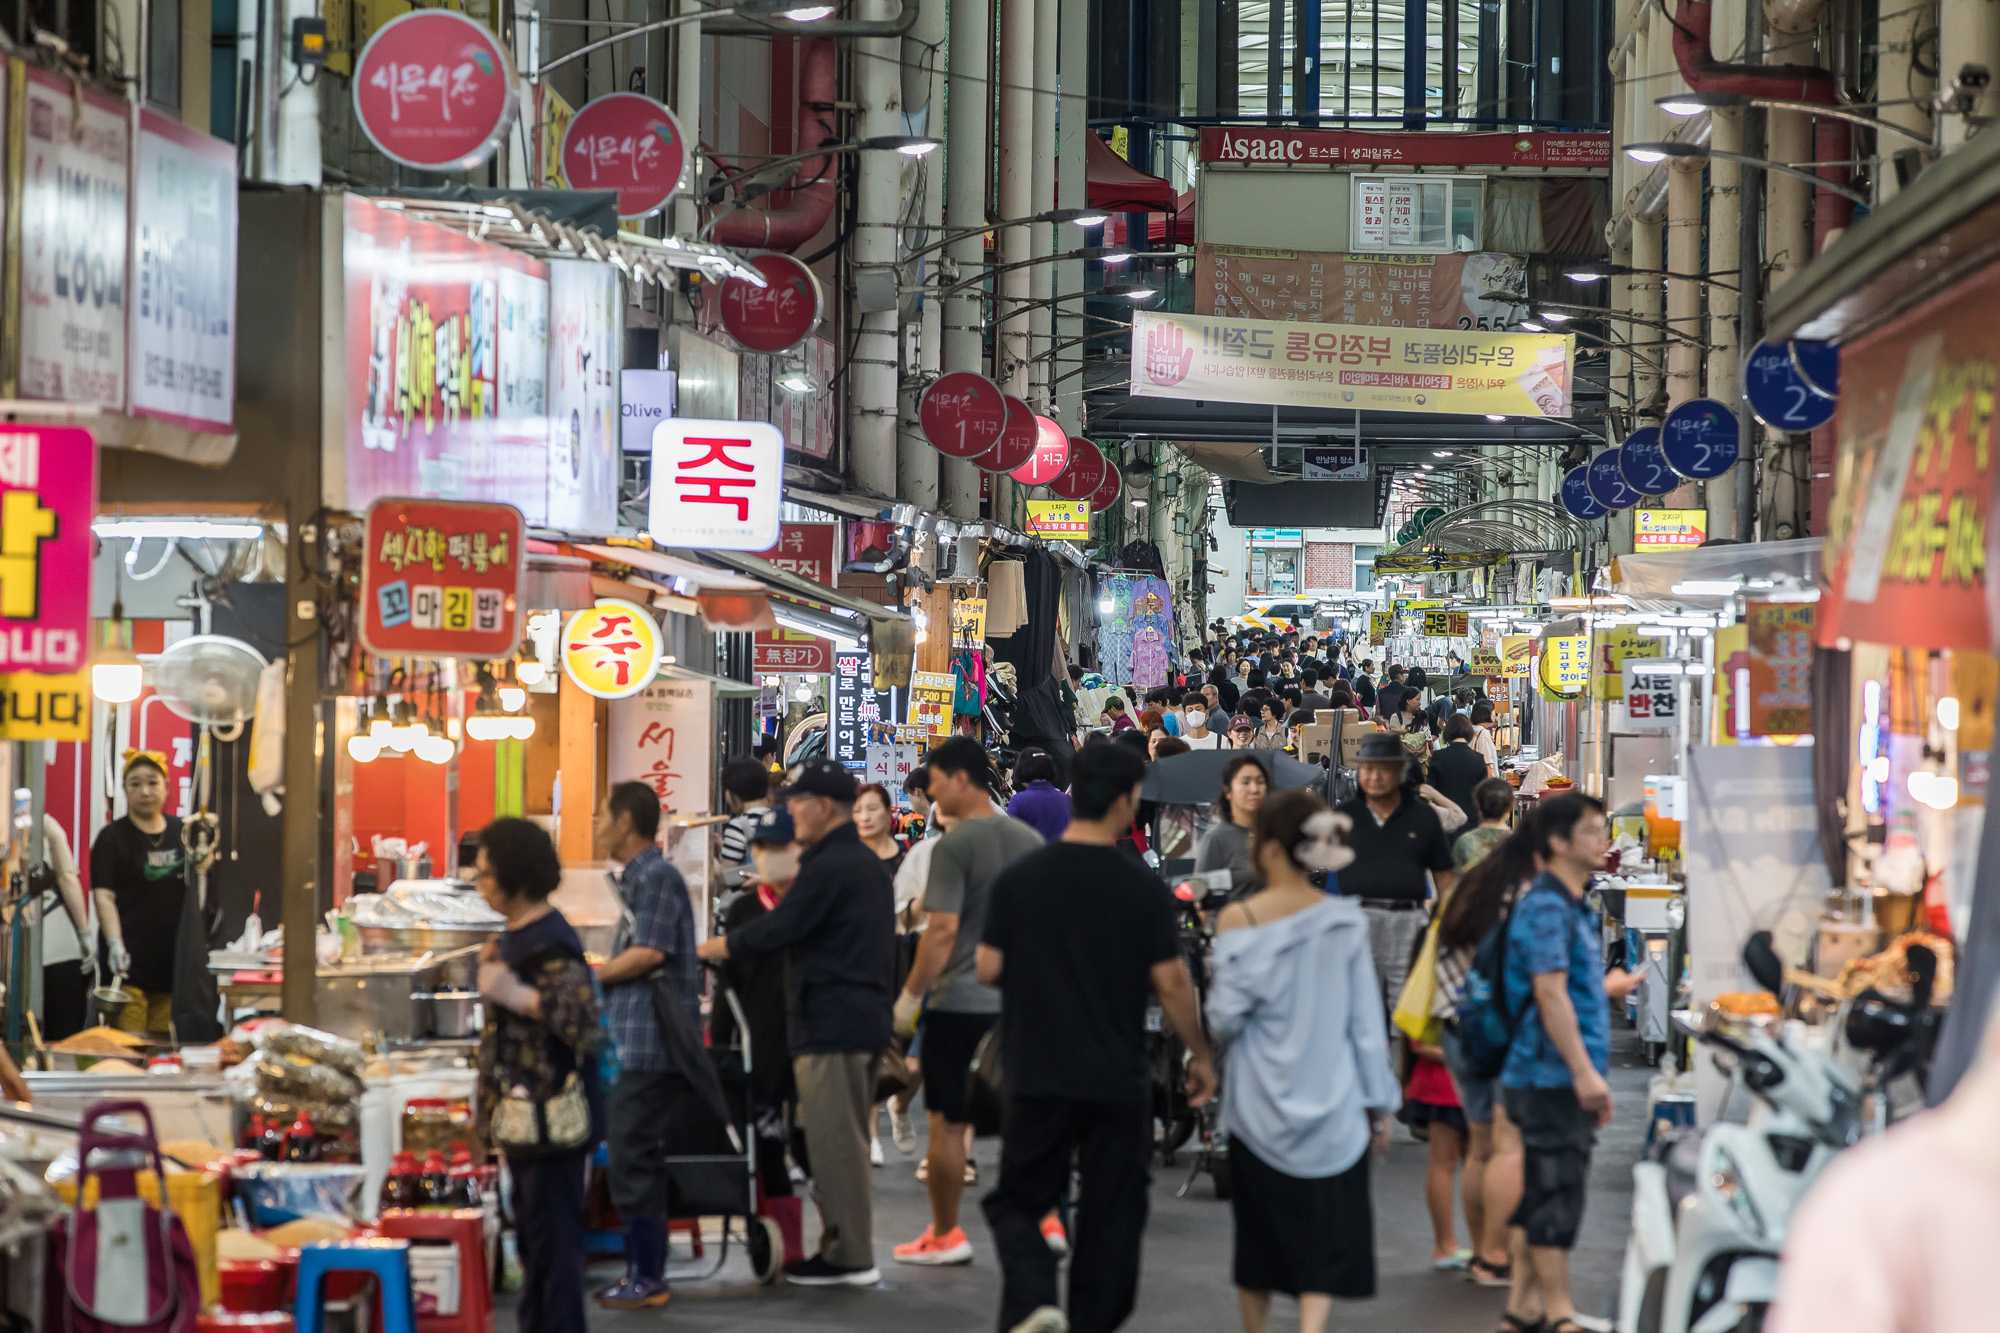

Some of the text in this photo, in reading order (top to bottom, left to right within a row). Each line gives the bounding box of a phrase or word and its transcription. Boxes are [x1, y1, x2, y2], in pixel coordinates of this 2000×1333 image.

[371, 61, 478, 122] 서문시장
[1220, 131, 1303, 160] Asaac
[1309, 147, 1403, 160] 토스트 생과일쥬스
[1567, 148, 1610, 156] 255-9400
[574, 134, 660, 182] 서문시장
[1395, 197, 1410, 205] 라면
[1395, 207, 1410, 215] 커피
[1344, 265, 1433, 280] 딸기 바나나
[1344, 278, 1431, 292] 키위 토마토
[1752, 355, 1794, 385] 서문시
[621, 402, 662, 418] Olive
[1784, 385, 1807, 421] 2
[955, 420, 998, 450] 1 지구
[1008, 437, 1031, 451] 지구
[1028, 453, 1038, 479] 1
[1042, 452, 1065, 466] 지구
[1315, 455, 1354, 464] 만남의 장소
[1692, 443, 1737, 472] 2 지구
[674, 436, 756, 522] 죽
[1067, 471, 1098, 493] 1 지구
[1645, 464, 1662, 489] 2
[1611, 481, 1626, 503] 2
[1077, 503, 1085, 513] 6
[1582, 495, 1595, 514] 2
[1642, 513, 1681, 522] 2 2지구
[1044, 523, 1086, 531] 소방대 통로
[1640, 535, 1687, 543] 소방대 통로
[569, 615, 642, 686] 죽
[766, 648, 814, 665] 無첨가
[836, 656, 860, 691] 쌀로
[913, 674, 956, 689] 납작만두
[941, 692, 950, 703] 원
[1629, 693, 1677, 718] 반찬
[838, 695, 856, 727] 만든
[920, 703, 941, 715] 만두
[896, 727, 927, 741] 작만두
[838, 729, 856, 760] 어묵
[881, 751, 904, 759] 수제
[875, 761, 911, 776] 식혜
